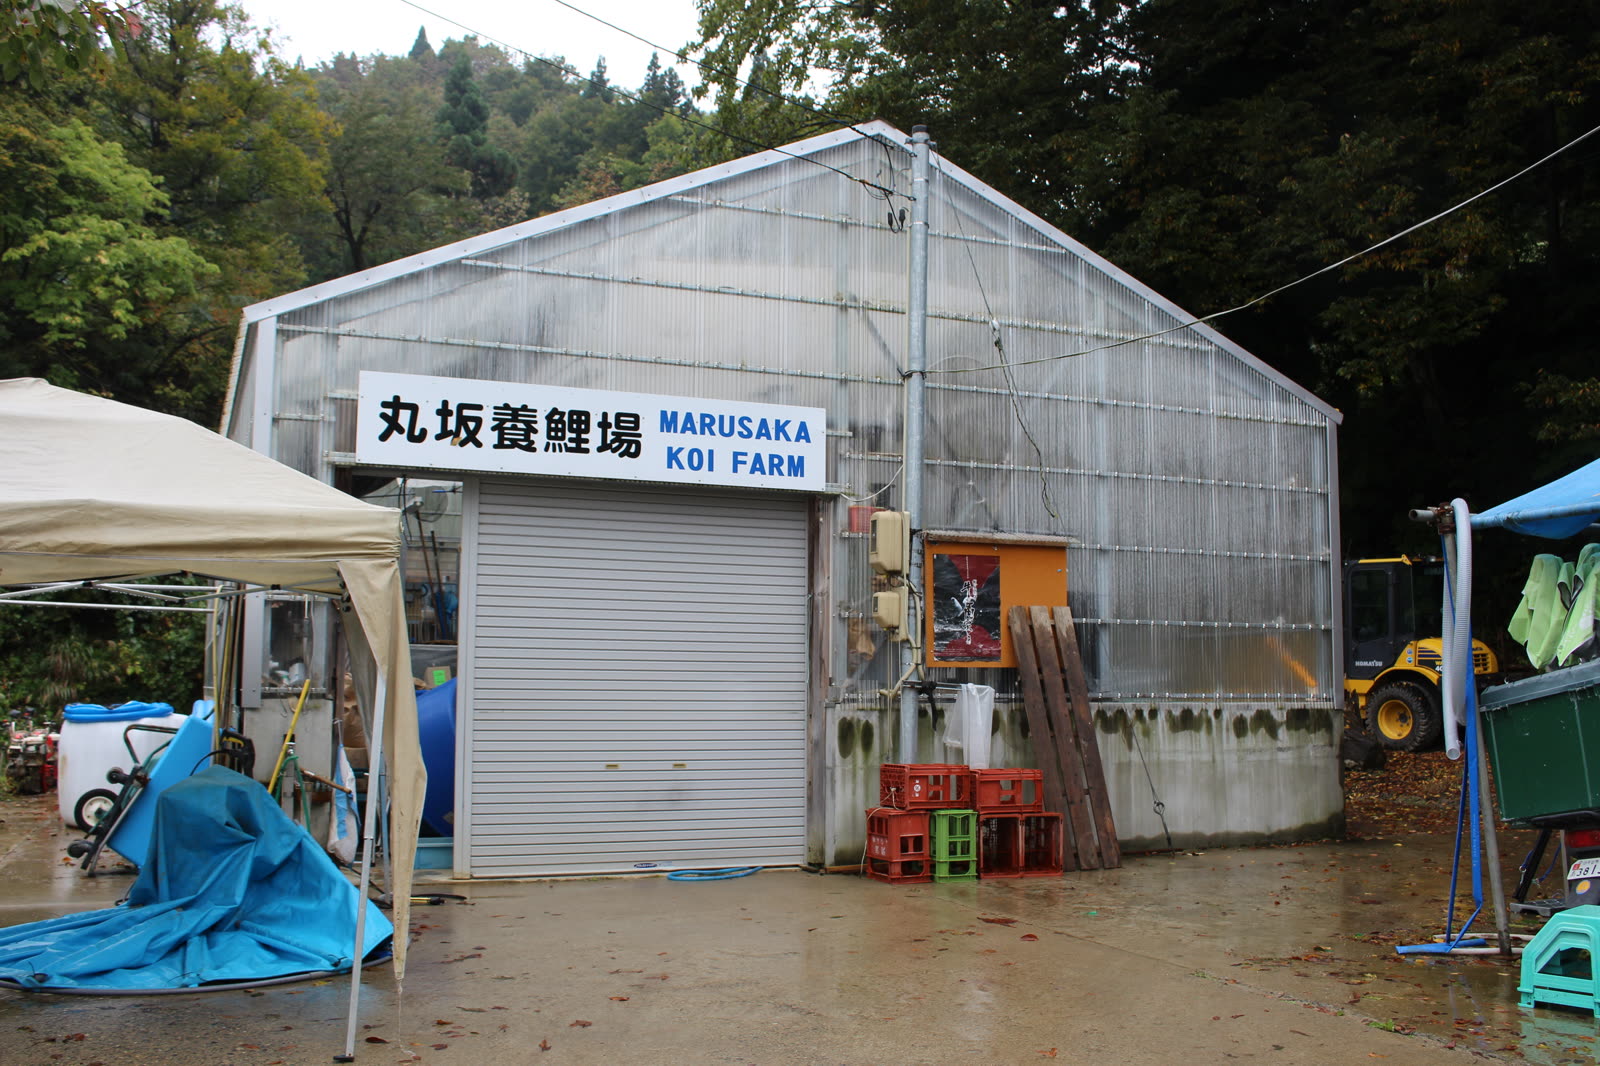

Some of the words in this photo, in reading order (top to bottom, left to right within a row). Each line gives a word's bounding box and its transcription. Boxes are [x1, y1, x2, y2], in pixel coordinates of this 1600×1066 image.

[378, 395, 643, 459] 丸坂養鯉場
[660, 410, 811, 443] MARUSAKA
[667, 446, 714, 472] KOI
[732, 451, 804, 477] FARM
[1355, 659, 1383, 667] KOMATSU
